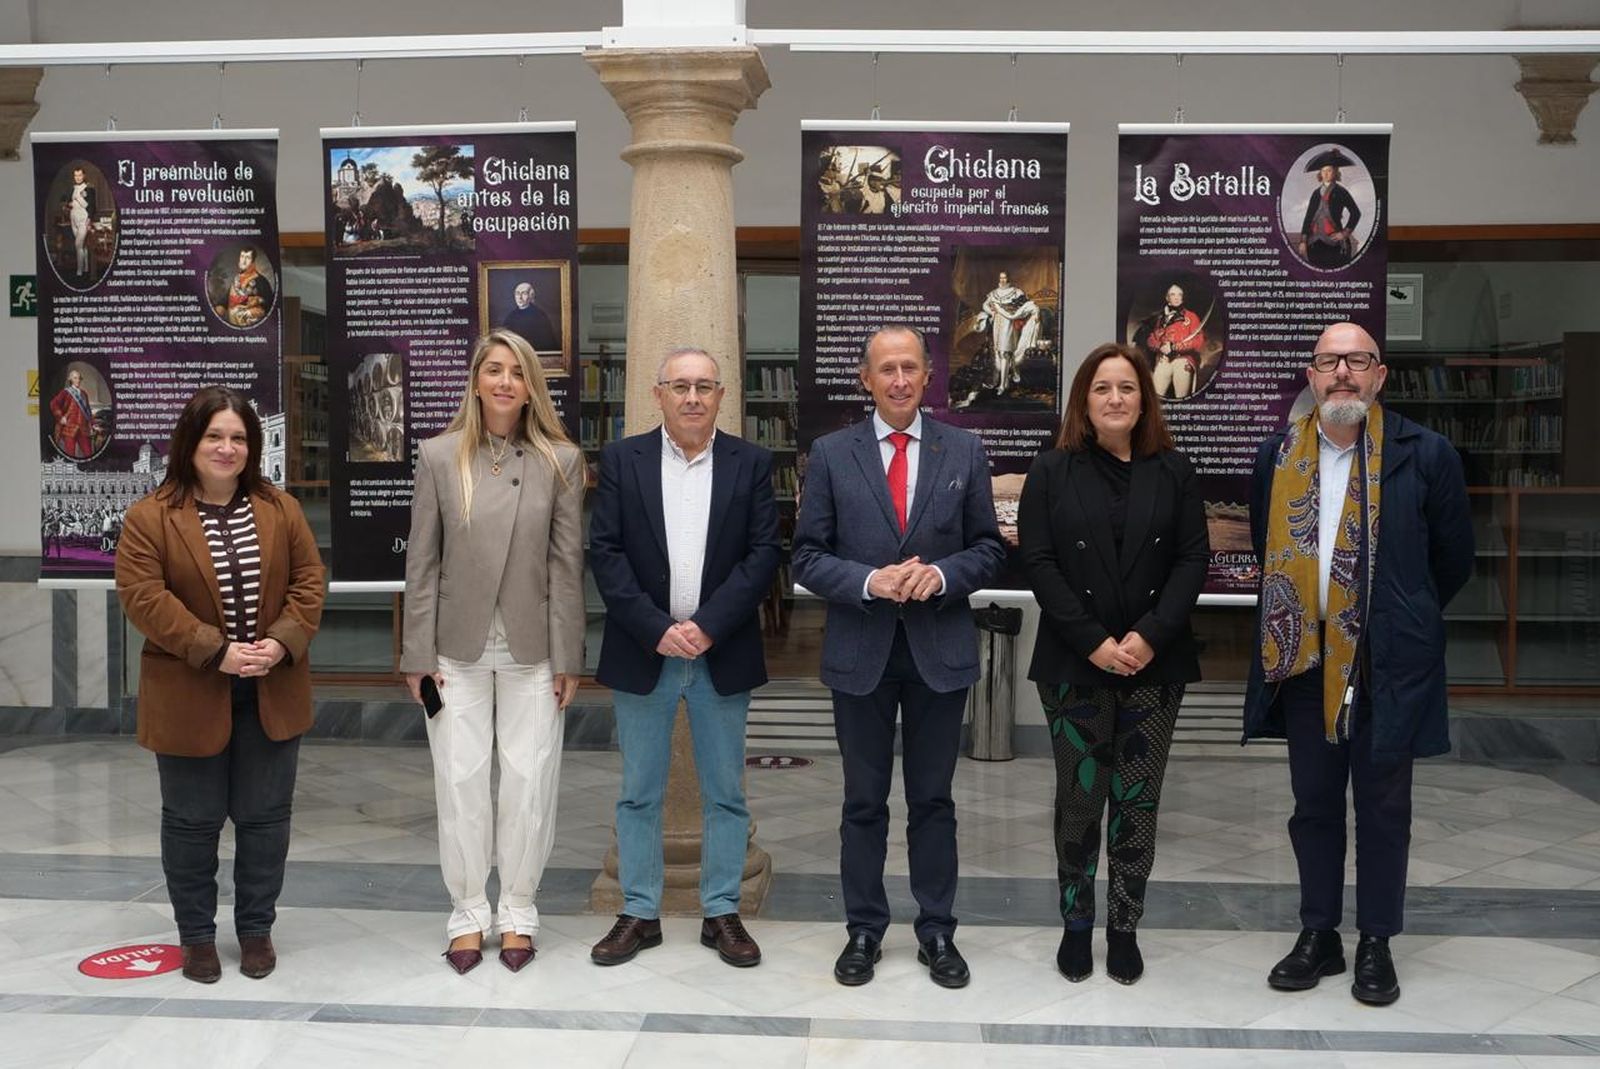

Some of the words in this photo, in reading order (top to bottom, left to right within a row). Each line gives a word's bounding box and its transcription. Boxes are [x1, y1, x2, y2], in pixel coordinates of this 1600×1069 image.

[118, 160, 135, 187] El
[143, 161, 227, 187] preámbulo
[235, 161, 253, 181] de
[483, 156, 570, 185] Chiclana
[924, 145, 1040, 183] Chiclana
[135, 189, 164, 203] una
[171, 183, 255, 203] revolución
[457, 188, 512, 207] antes
[521, 183, 543, 206] de
[553, 183, 570, 206] la
[911, 184, 963, 202] ocupada
[968, 187, 989, 203] por
[995, 185, 1006, 199] el
[1134, 164, 1160, 206] La
[1170, 163, 1270, 202] Batalla
[890, 200, 938, 218] ejército
[945, 200, 994, 219] imperial
[1000, 201, 1049, 215] francés
[473, 212, 570, 239] ocupación
[92, 946, 166, 966] SALIDA
